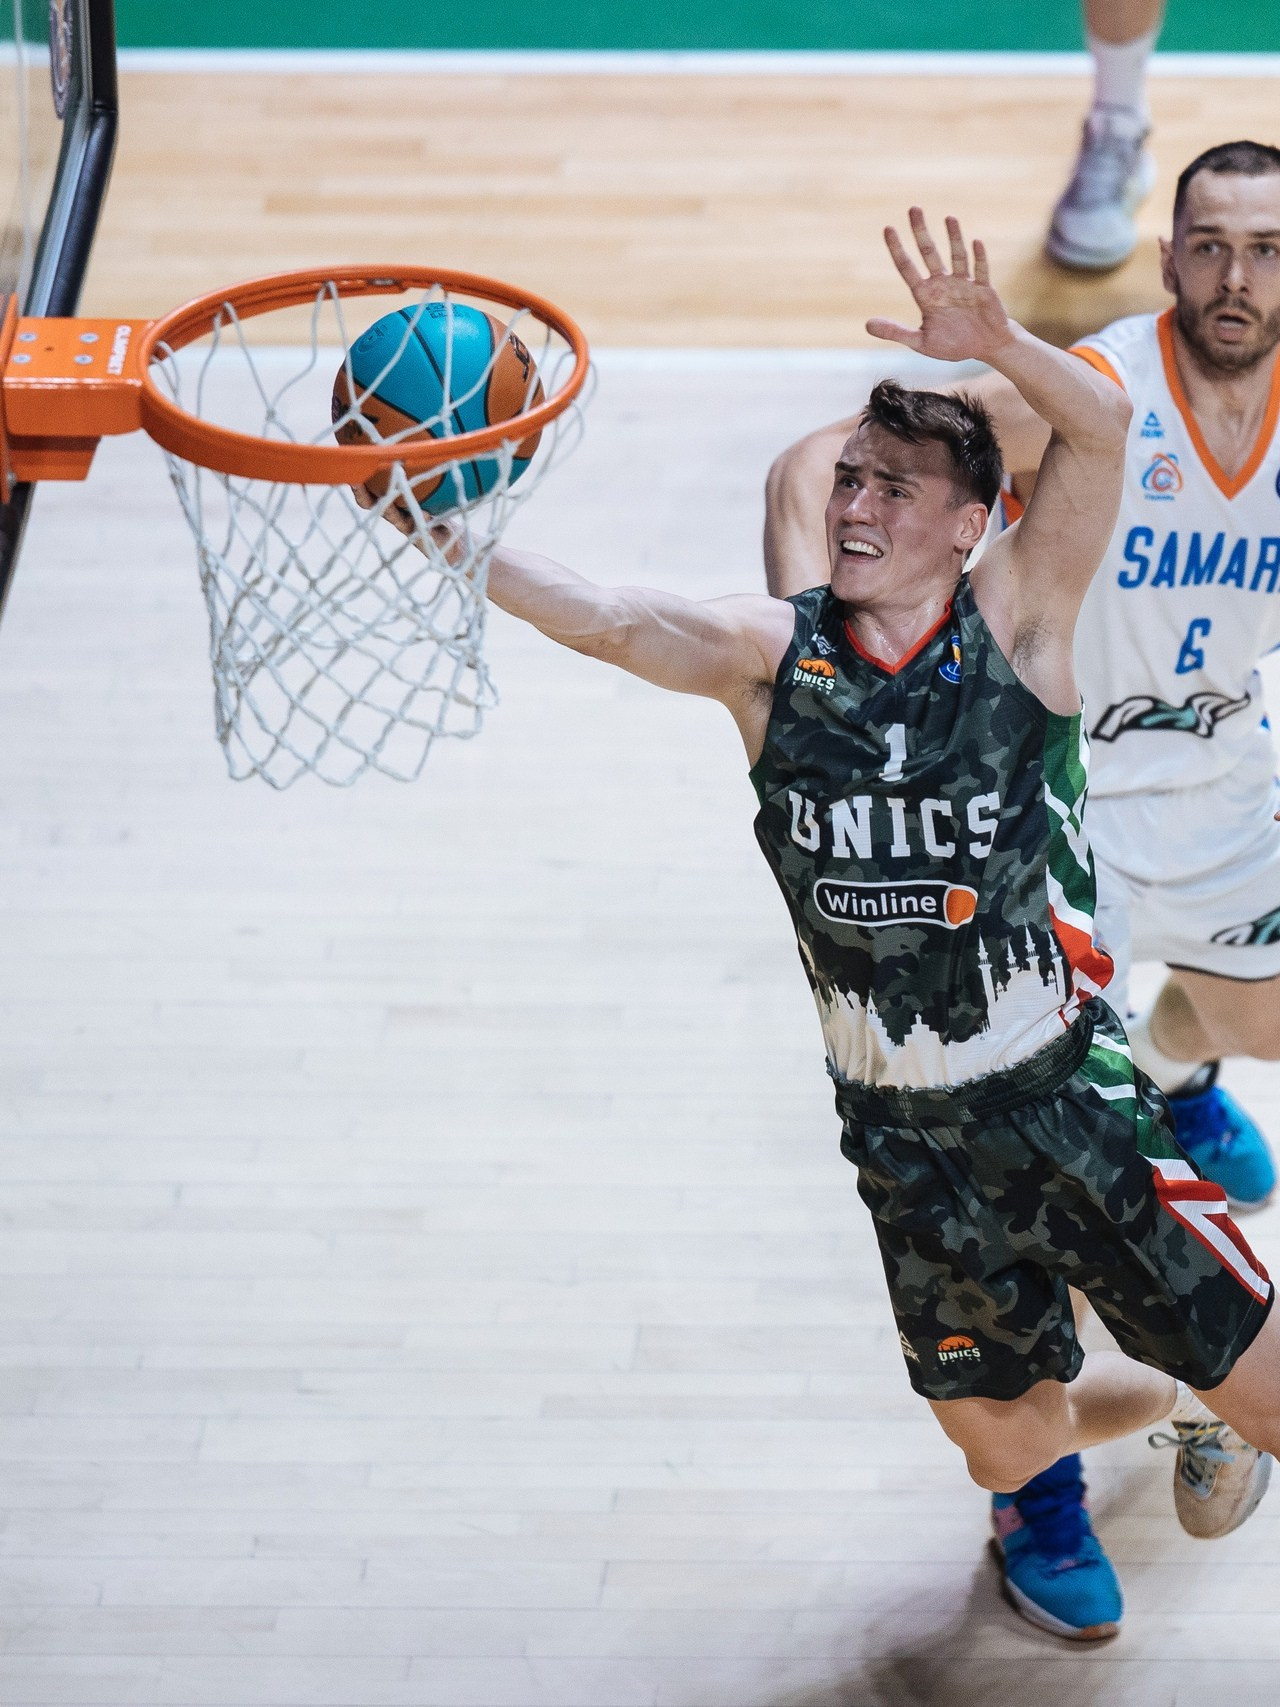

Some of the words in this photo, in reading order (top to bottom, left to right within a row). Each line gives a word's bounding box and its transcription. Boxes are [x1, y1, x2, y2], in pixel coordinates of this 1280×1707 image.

[1175, 617, 1211, 674] 6
[793, 667, 836, 690] UNICS
[879, 723, 906, 782] 1
[789, 790, 1000, 859] UNICS
[824, 889, 937, 915] Winline
[938, 1347, 980, 1361] UNICS
